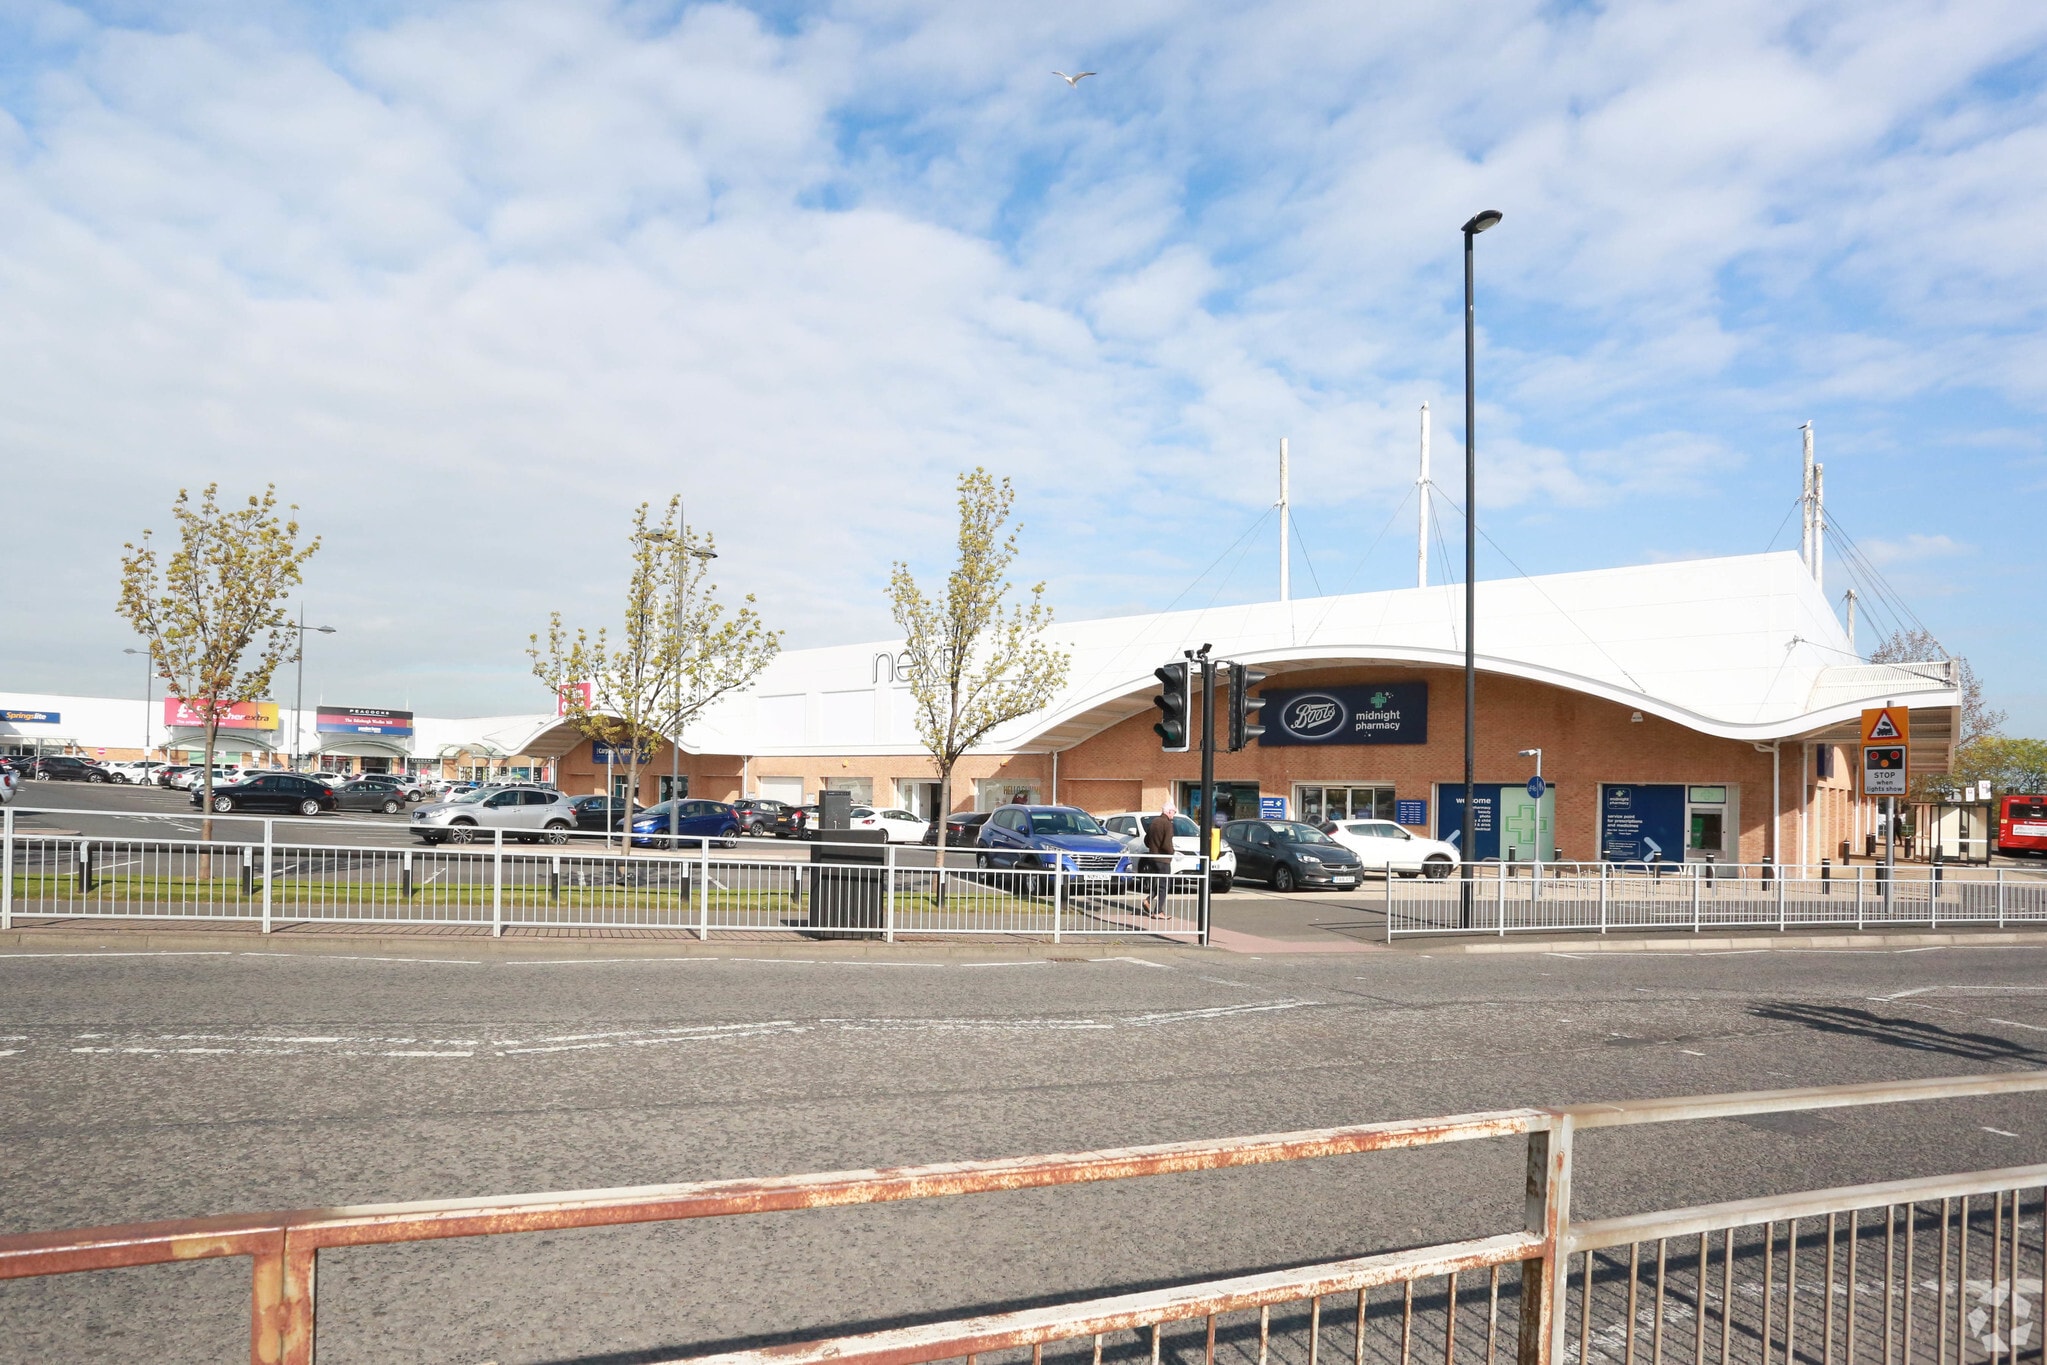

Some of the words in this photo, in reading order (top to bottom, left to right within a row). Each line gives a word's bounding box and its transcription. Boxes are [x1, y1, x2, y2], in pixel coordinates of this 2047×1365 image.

[873, 643, 954, 684] next
[1291, 703, 1335, 729] Boots
[1356, 711, 1400, 721] midnight
[1356, 721, 1400, 732] pharmacy
